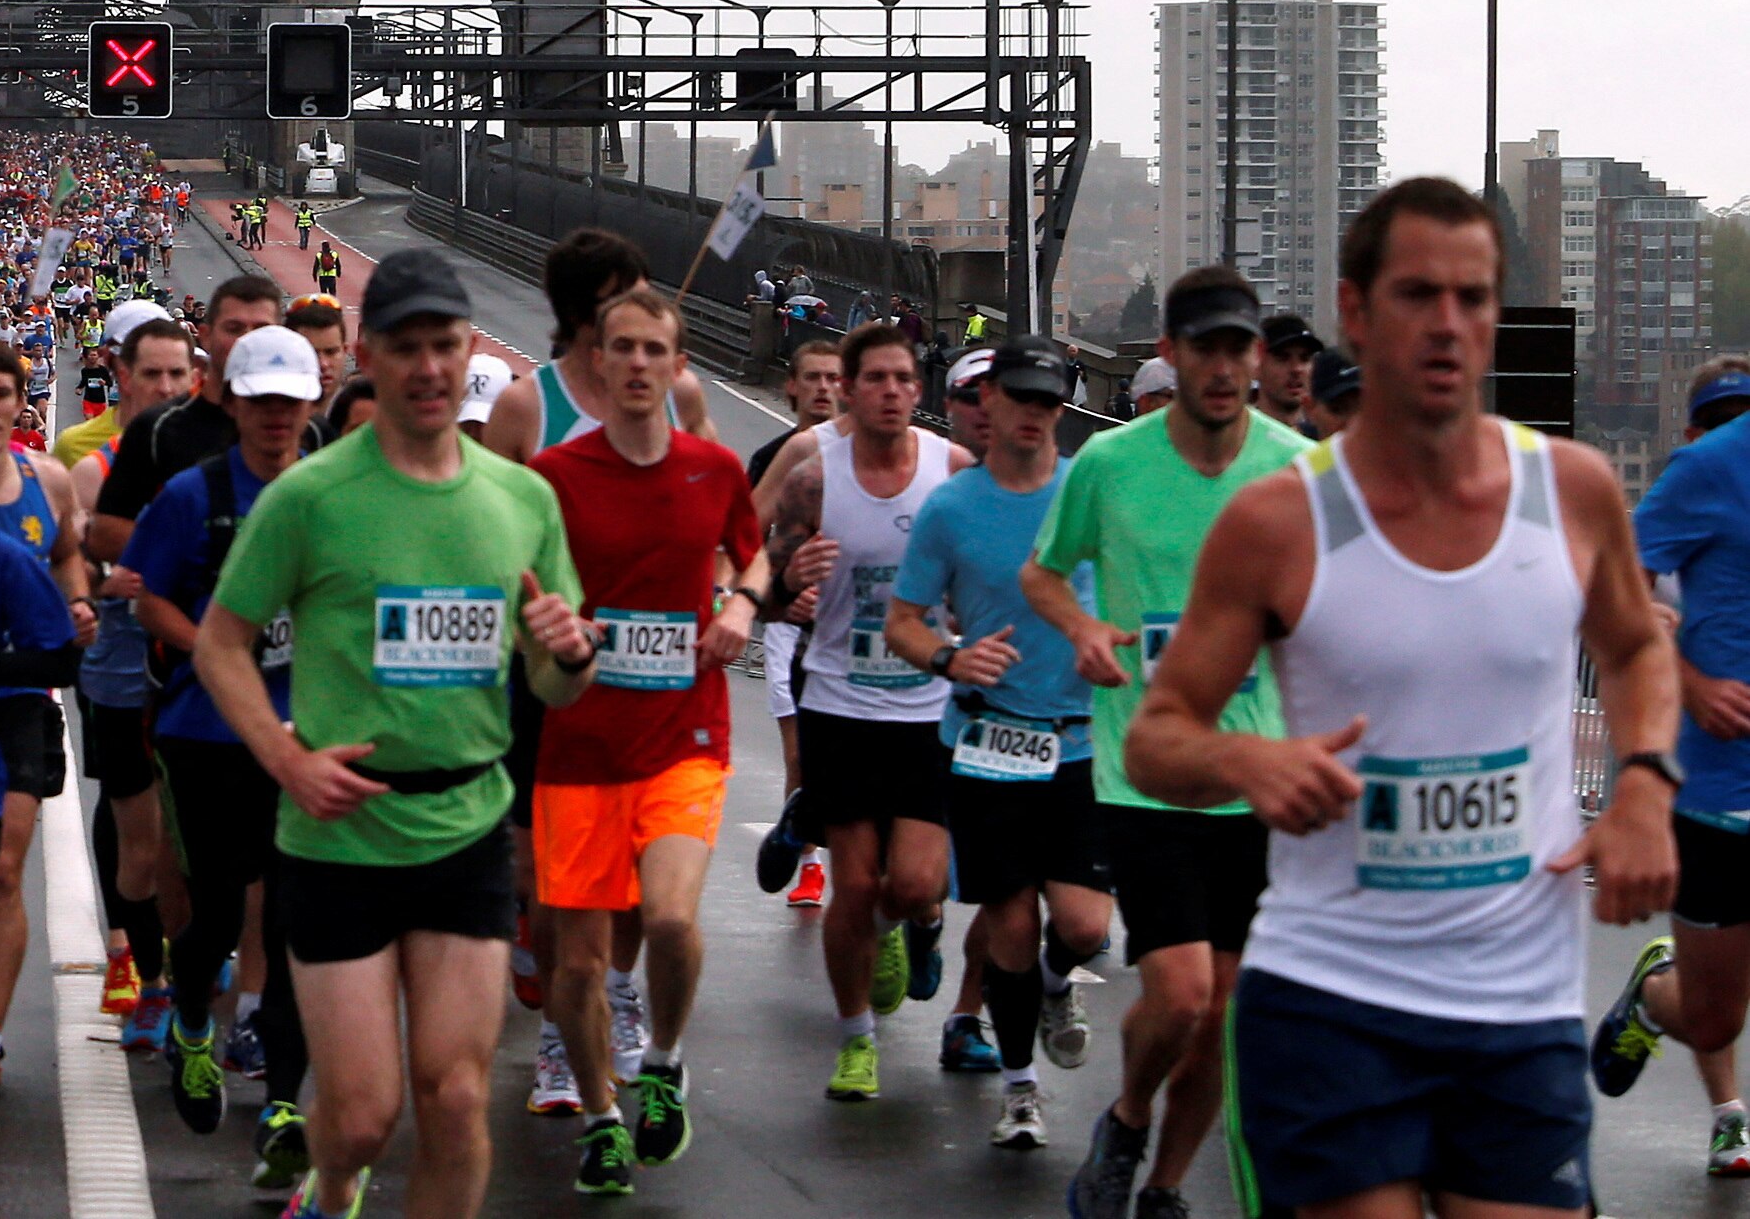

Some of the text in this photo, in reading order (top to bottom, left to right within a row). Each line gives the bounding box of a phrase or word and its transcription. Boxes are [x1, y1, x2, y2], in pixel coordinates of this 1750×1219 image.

[122, 96, 139, 115] 5
[301, 96, 318, 115] 6
[381, 605, 496, 642] A 10889
[627, 626, 686, 655] 10274
[988, 726, 1053, 762] 10246
[1367, 774, 1518, 833] A 10615
